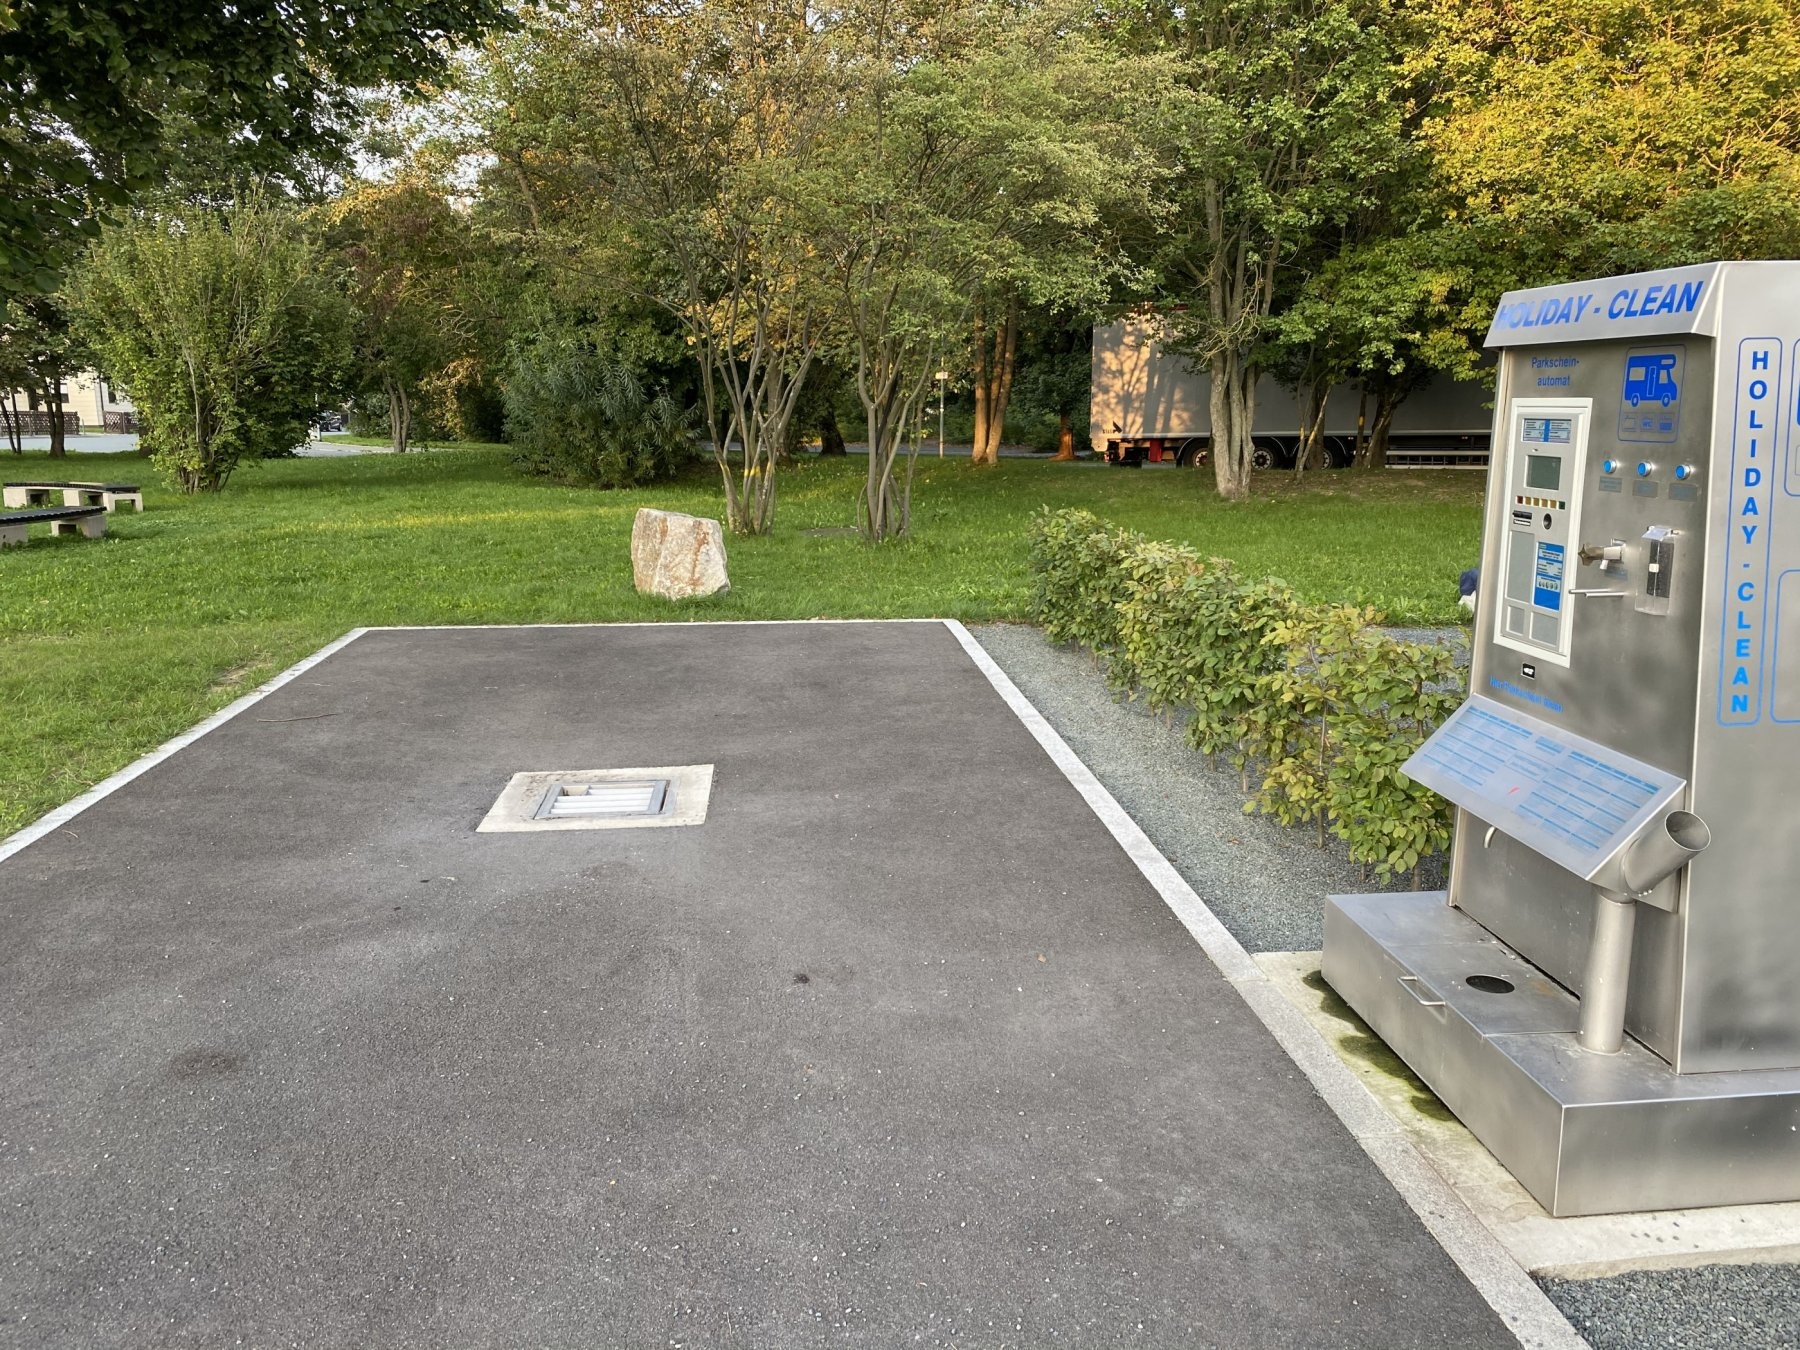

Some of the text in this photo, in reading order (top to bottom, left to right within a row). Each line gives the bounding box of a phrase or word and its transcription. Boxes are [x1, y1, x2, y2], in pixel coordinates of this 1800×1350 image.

[1494, 294, 1593, 330] HOLIDAY
[1608, 281, 1704, 320] CLEAN
[1531, 355, 1580, 369] Parkschein-
[1537, 374, 1571, 387] automat
[1741, 350, 1769, 545] HOLIDAY
[1731, 582, 1754, 713] CLEAN
